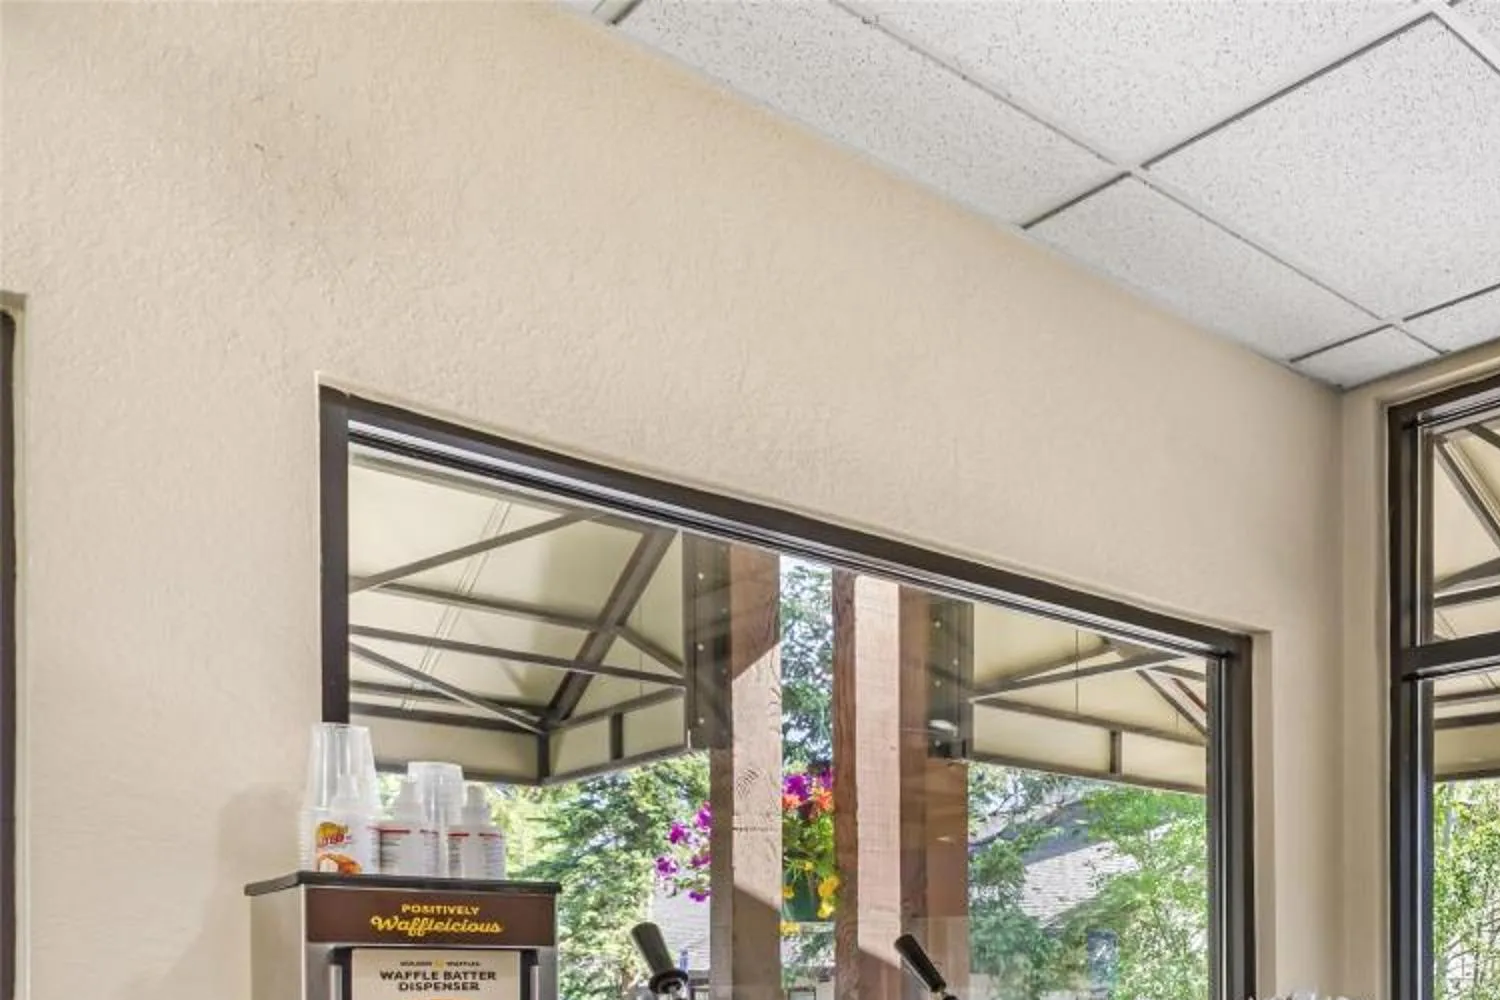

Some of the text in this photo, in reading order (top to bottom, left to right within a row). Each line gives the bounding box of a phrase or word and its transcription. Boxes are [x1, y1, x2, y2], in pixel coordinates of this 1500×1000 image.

[401, 903, 480, 915] POSITIVELY
[379, 970, 496, 981] WAFFLE BATTER
[398, 981, 480, 992] DISPENSER
